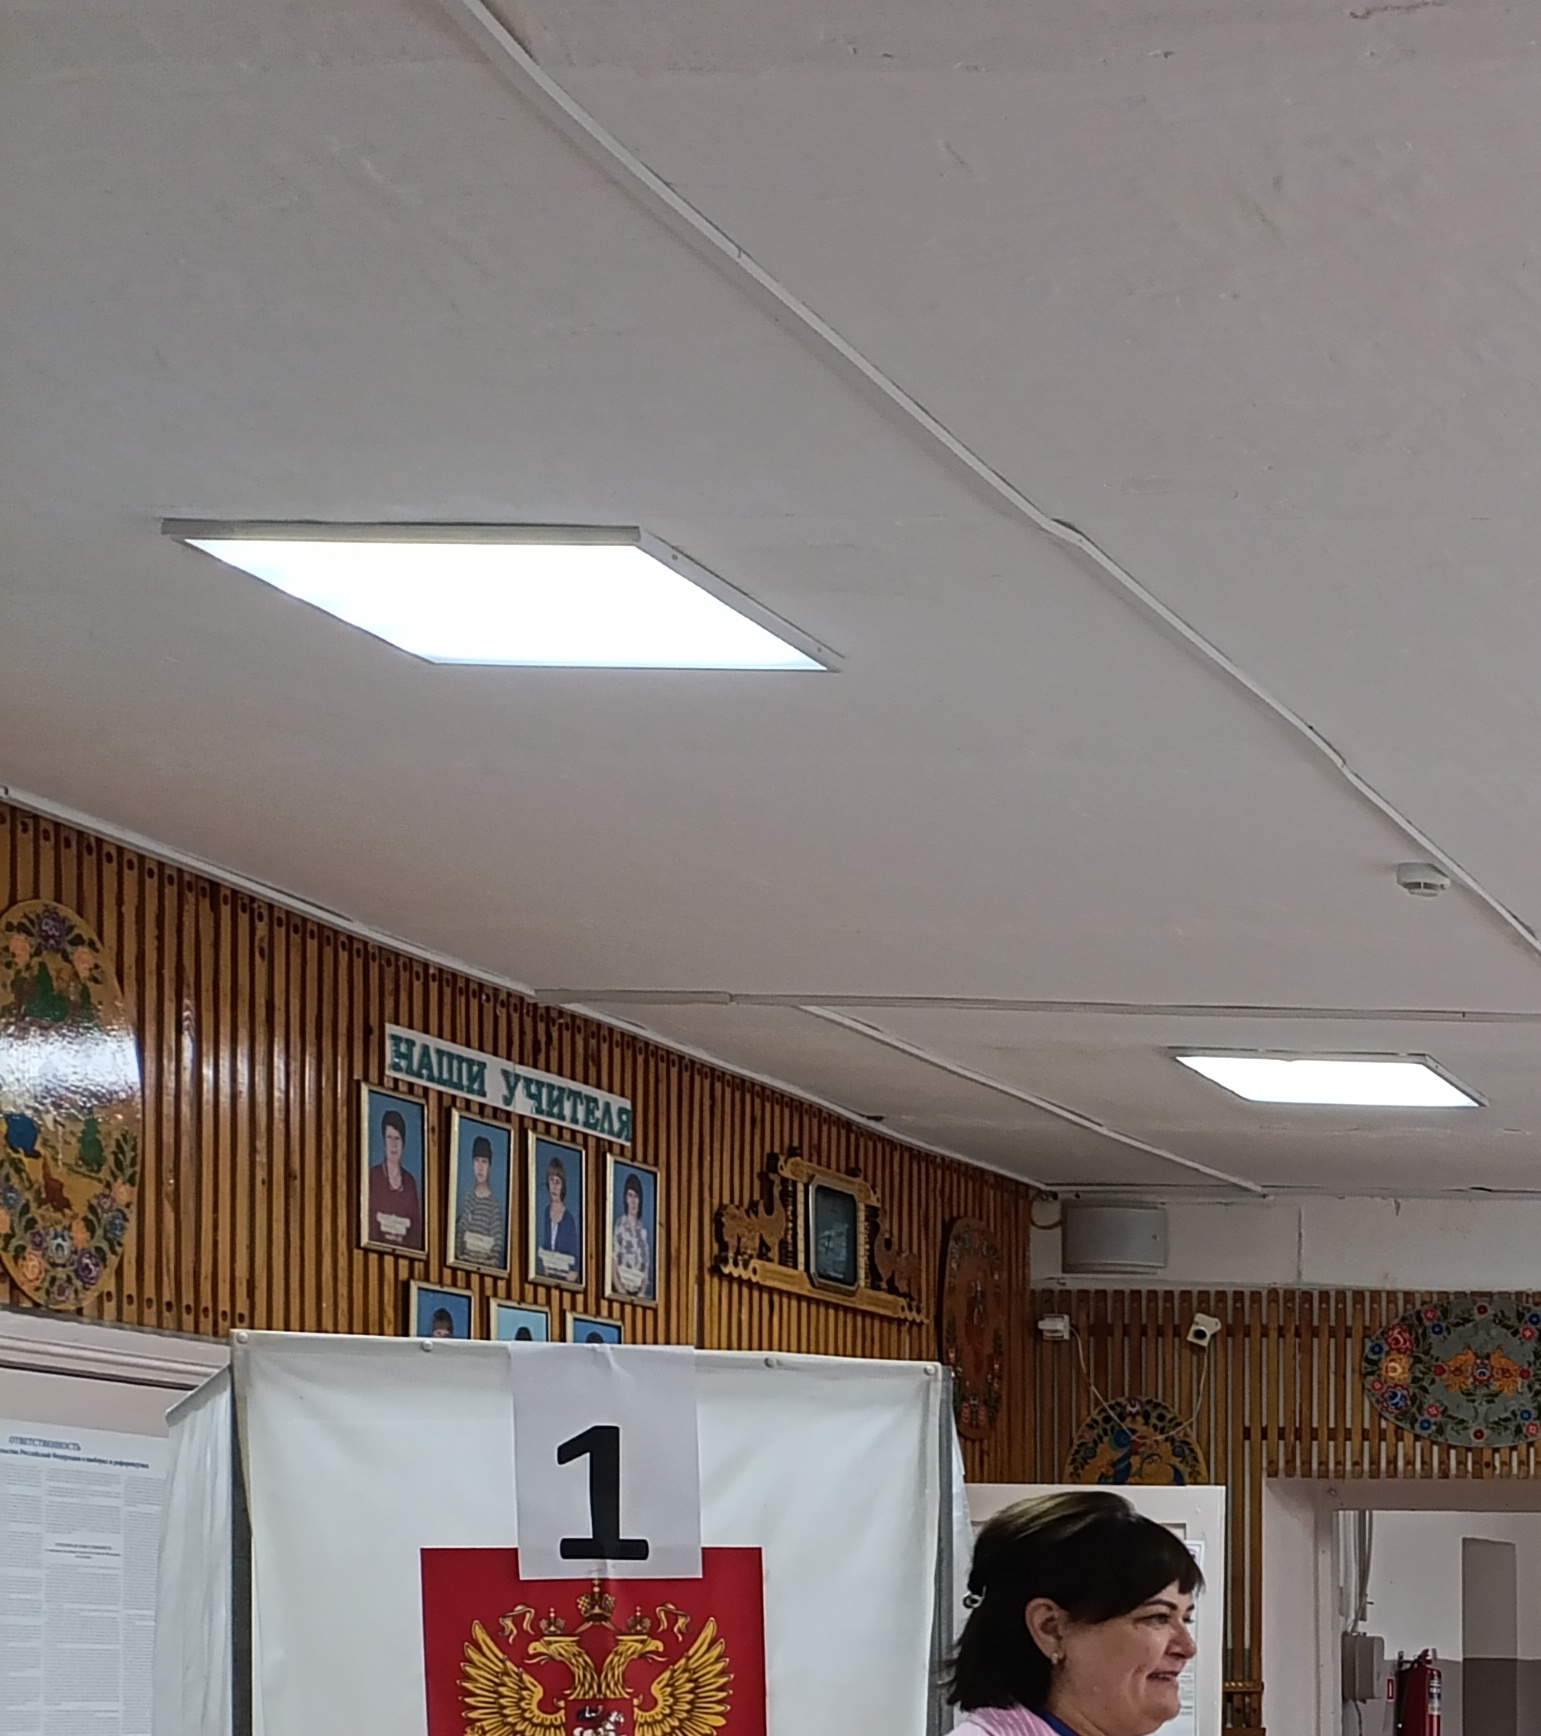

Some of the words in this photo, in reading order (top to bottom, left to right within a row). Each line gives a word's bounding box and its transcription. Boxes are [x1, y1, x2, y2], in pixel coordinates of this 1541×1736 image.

[389, 1032, 488, 1098] НАШИ
[500, 1068, 633, 1142] УЧИТЕЛЯ
[8, 1436, 81, 1451] ОТВЕТСТВЕННОСТЬ
[557, 1425, 649, 1560] 1
